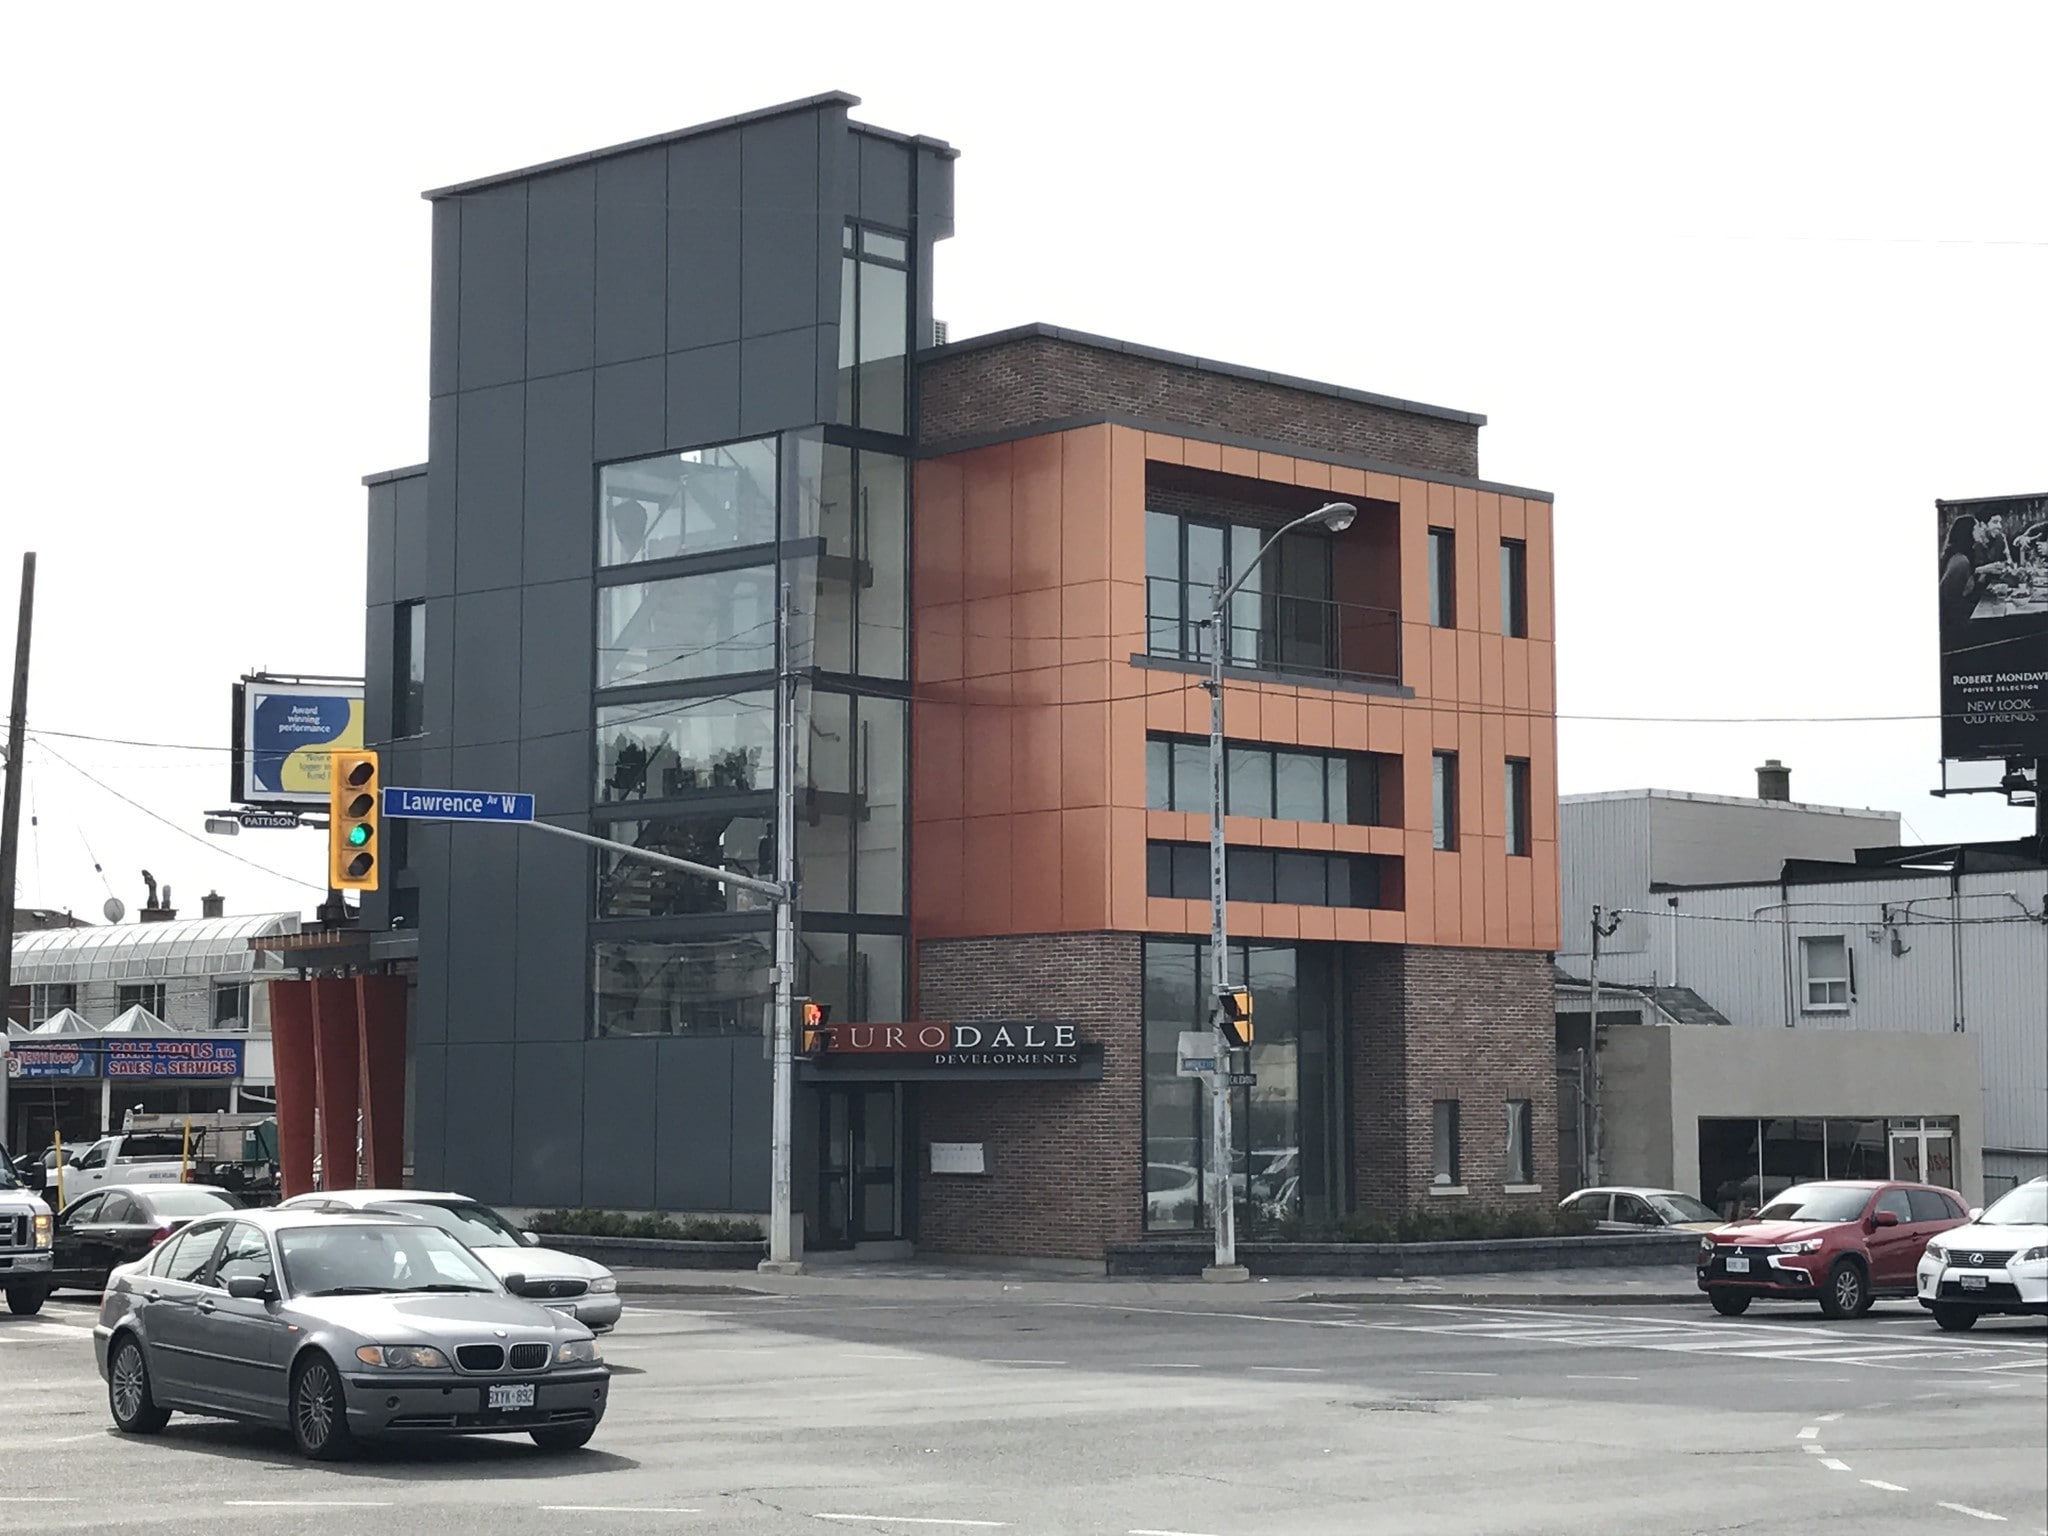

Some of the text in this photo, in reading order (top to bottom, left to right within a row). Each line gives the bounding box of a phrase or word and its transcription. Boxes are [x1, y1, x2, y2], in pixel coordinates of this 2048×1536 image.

[1953, 674, 1993, 685] ROBERT
[1997, 684, 2039, 692] SELECTION
[291, 705, 318, 714] Award
[1967, 700, 1997, 711] NEW
[287, 714, 321, 725] winning
[1963, 712, 1987, 724] OLD
[278, 723, 331, 733] performance
[403, 792, 516, 814] Lawrence Av W
[245, 816, 296, 826] PATTISON
[157, 1043, 213, 1059] TOOLS
[935, 1054, 1077, 1064] DEVELOPMENTS
[109, 1061, 236, 1074] SALES & SERVICES
